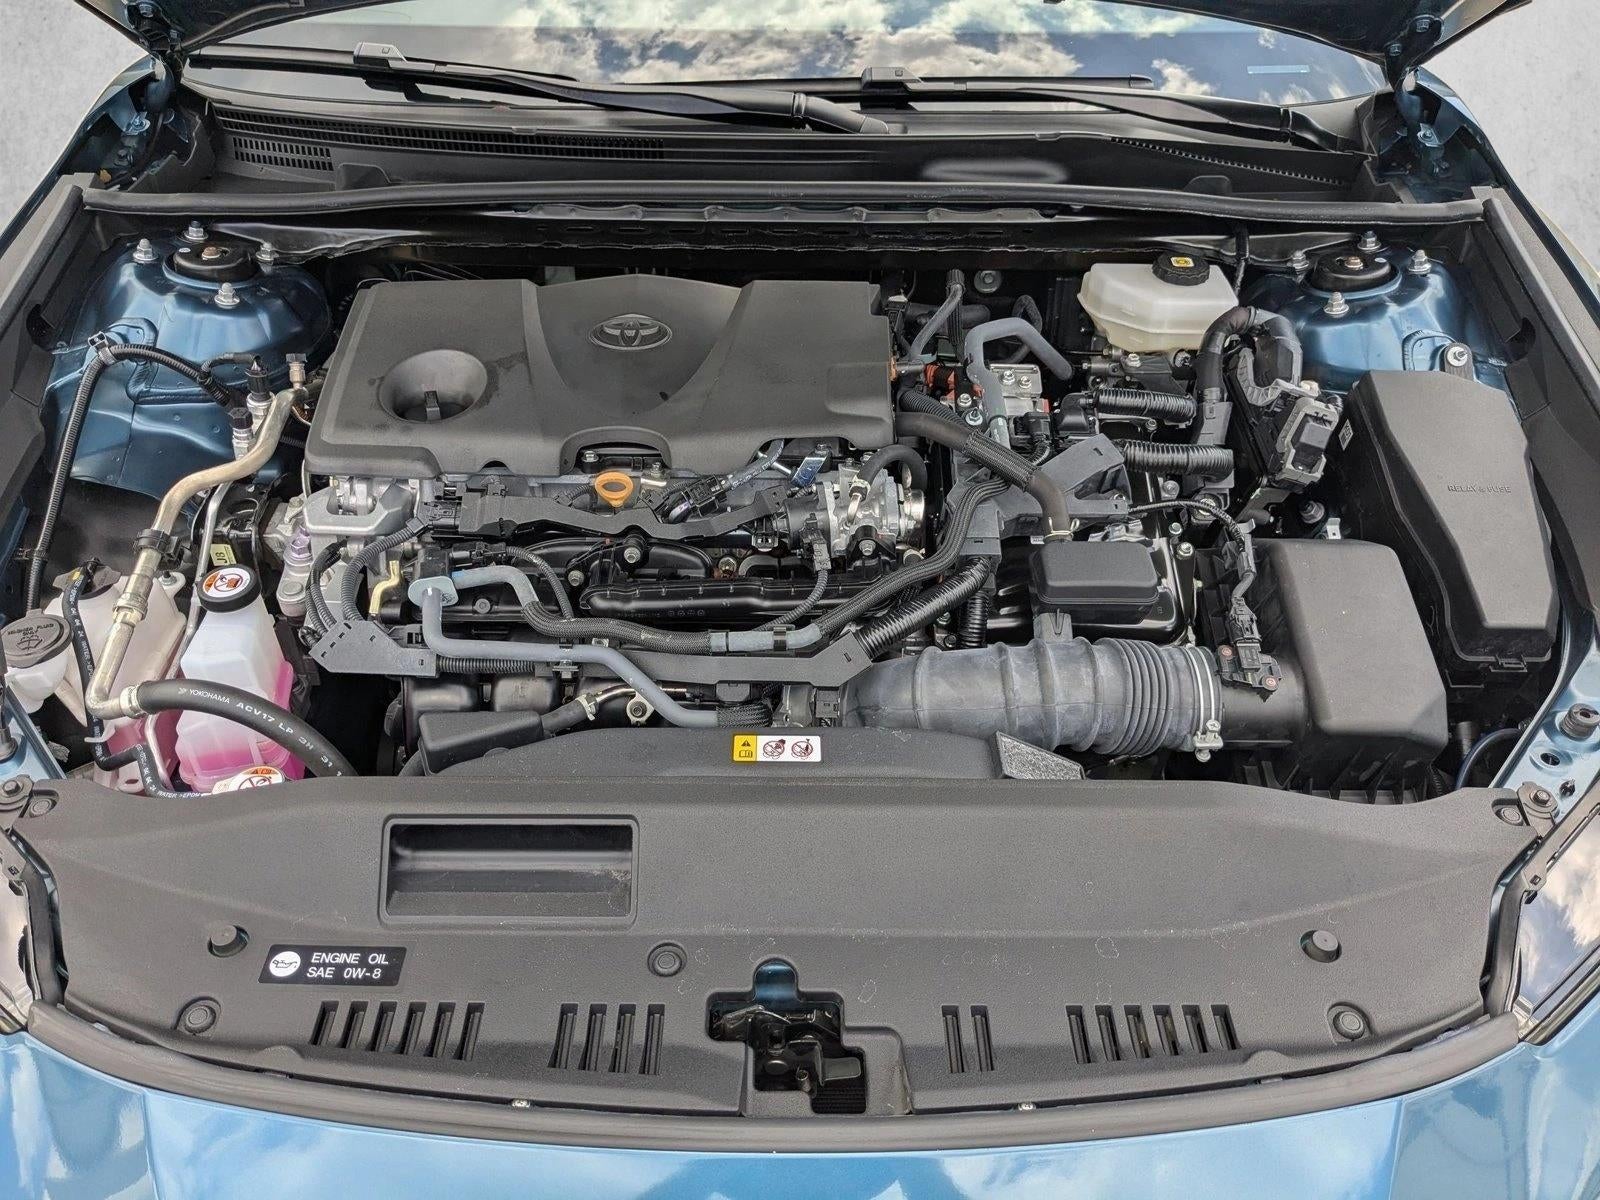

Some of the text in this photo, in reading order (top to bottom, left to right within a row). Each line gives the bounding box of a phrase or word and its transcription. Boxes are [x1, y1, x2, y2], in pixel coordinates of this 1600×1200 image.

[189, 688, 231, 704] YOKOHAMA
[235, 702, 275, 722] ACV17
[278, 722, 294, 734] LP
[157, 790, 177, 799] WATER
[310, 952, 389, 965] ENGINE OIL
[306, 966, 382, 979] SAE 0W-8
